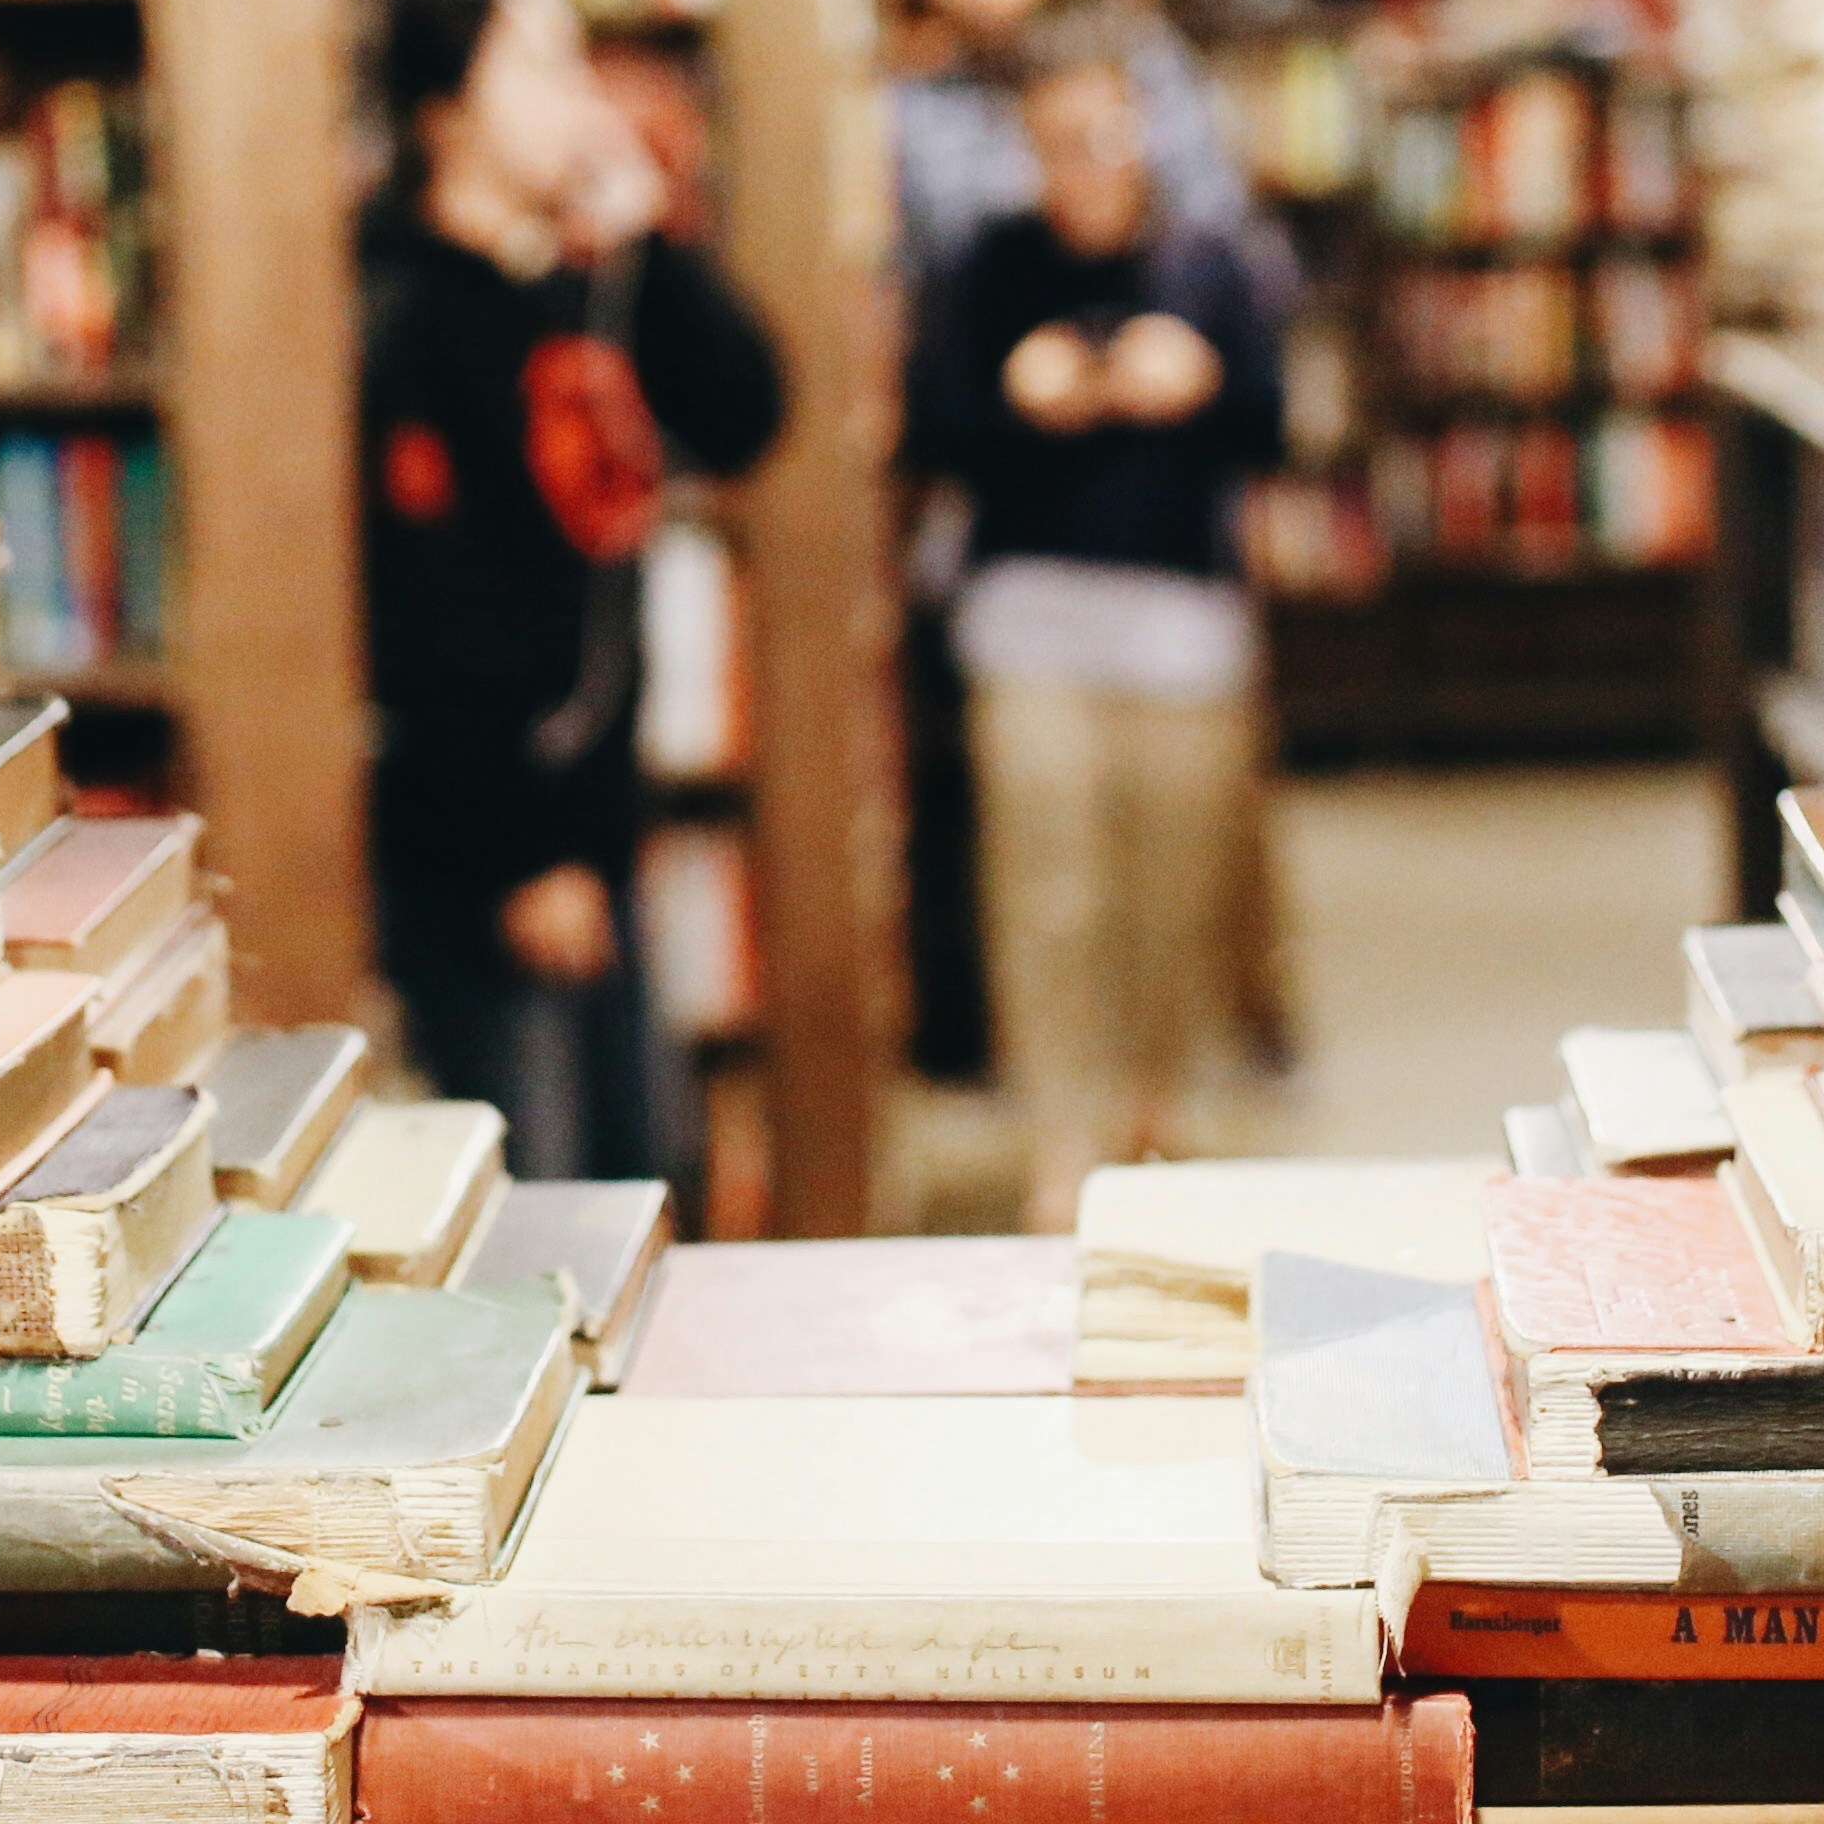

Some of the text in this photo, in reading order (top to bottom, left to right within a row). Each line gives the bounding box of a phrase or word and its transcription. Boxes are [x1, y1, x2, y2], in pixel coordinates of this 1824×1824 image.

[1669, 1609, 1698, 1647] A
[1722, 1608, 1820, 1647] MAN
[410, 1660, 1154, 1683] THE DIARIES OF ETTY HILLESUM
[857, 1735, 875, 1806] Adams
